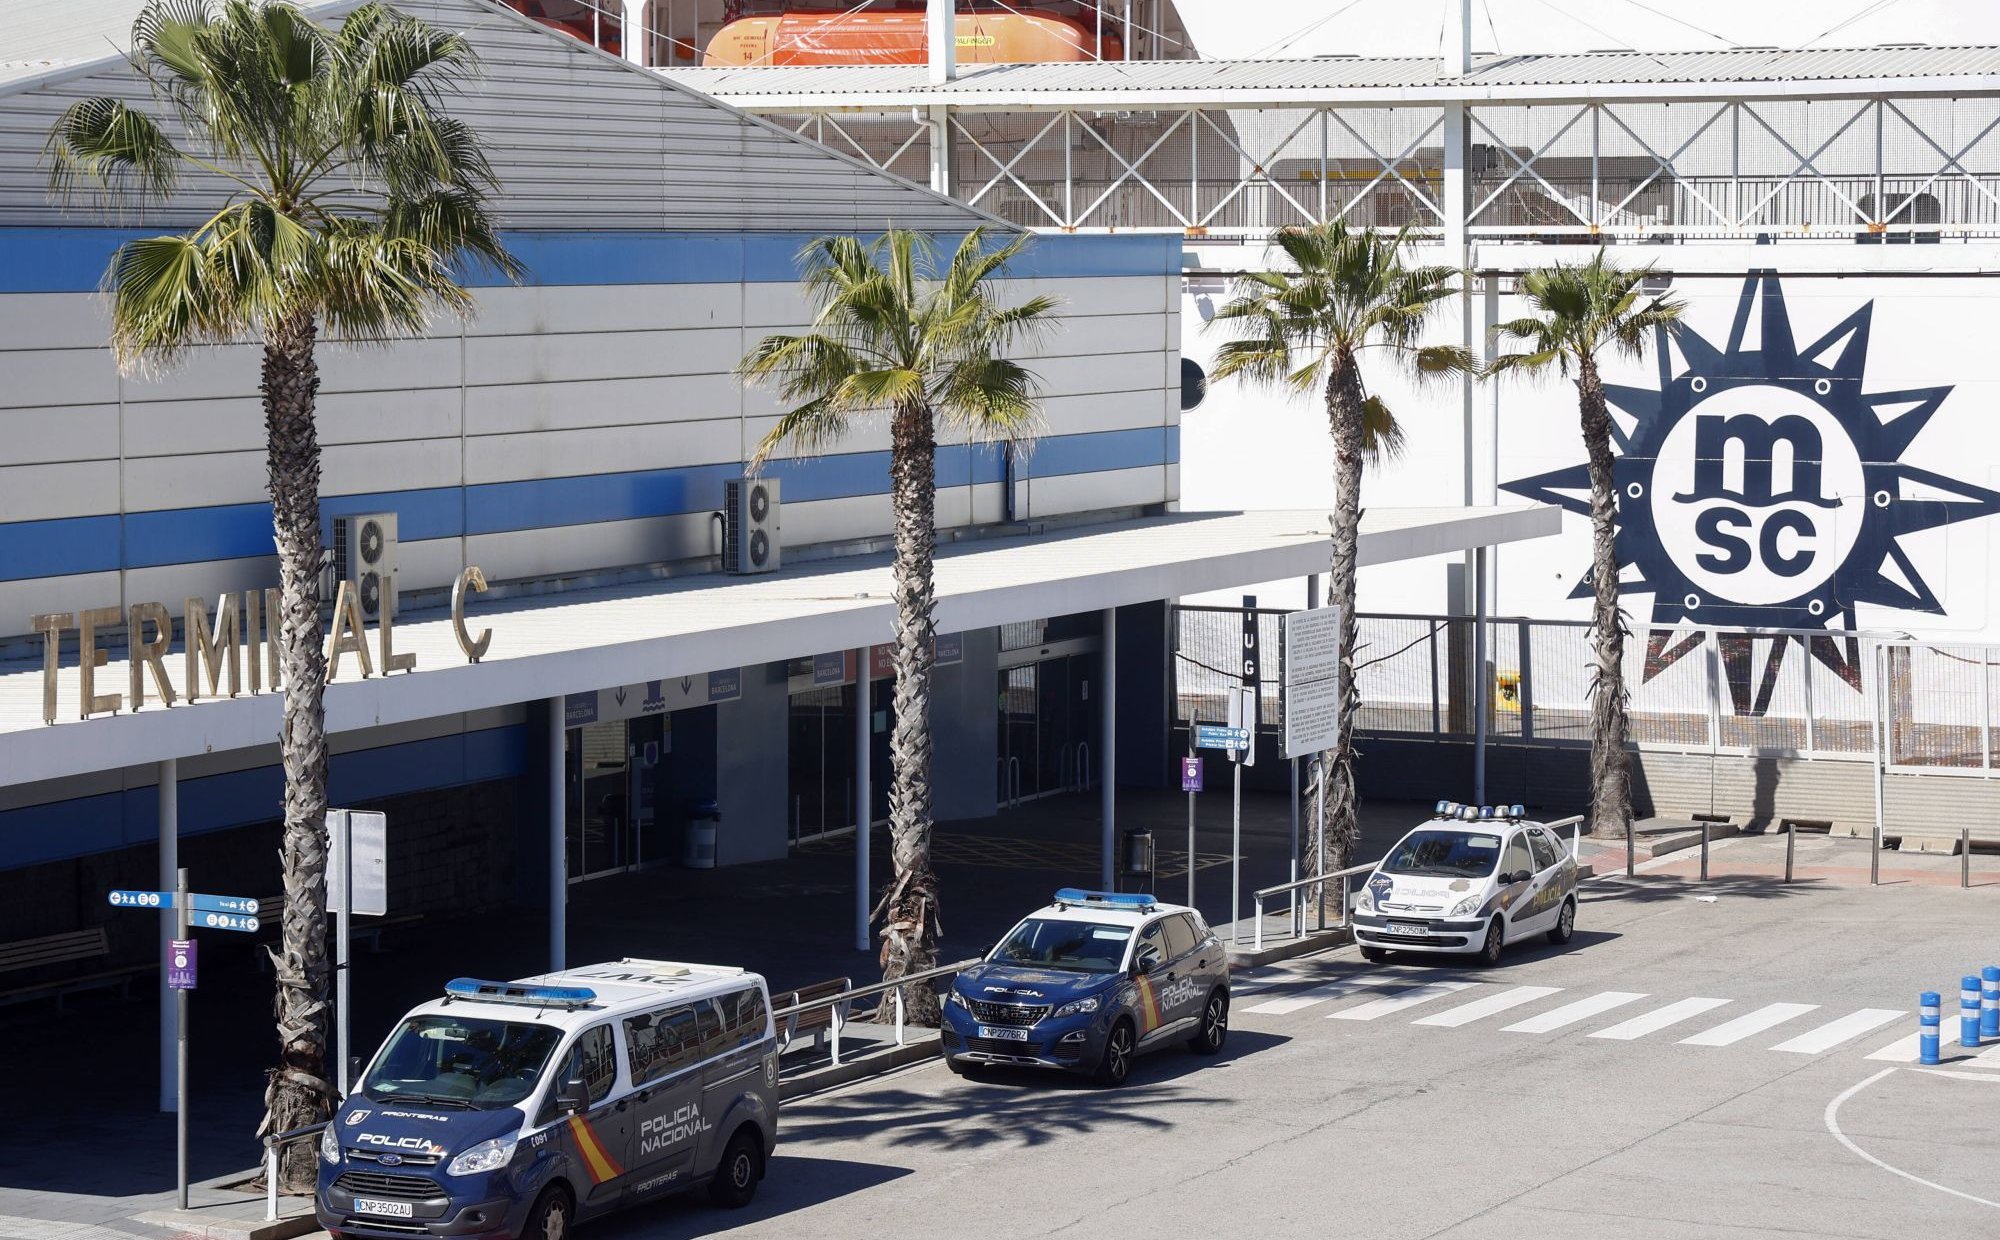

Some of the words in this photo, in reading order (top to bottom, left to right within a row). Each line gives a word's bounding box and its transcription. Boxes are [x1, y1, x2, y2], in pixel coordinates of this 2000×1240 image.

[744, 52, 753, 60] 14
[452, 566, 492, 661] C
[711, 684, 737, 695] BARCELONA
[1162, 986, 1203, 1012] NACIONAL
[381, 1111, 448, 1122] FRONTERAS
[641, 1101, 699, 1137] POLICÍA
[357, 1133, 434, 1149] POLICÍA
[535, 1132, 548, 1145] 091
[641, 1117, 712, 1155] NACIONAL
[637, 1170, 679, 1194] FRONTERAS
